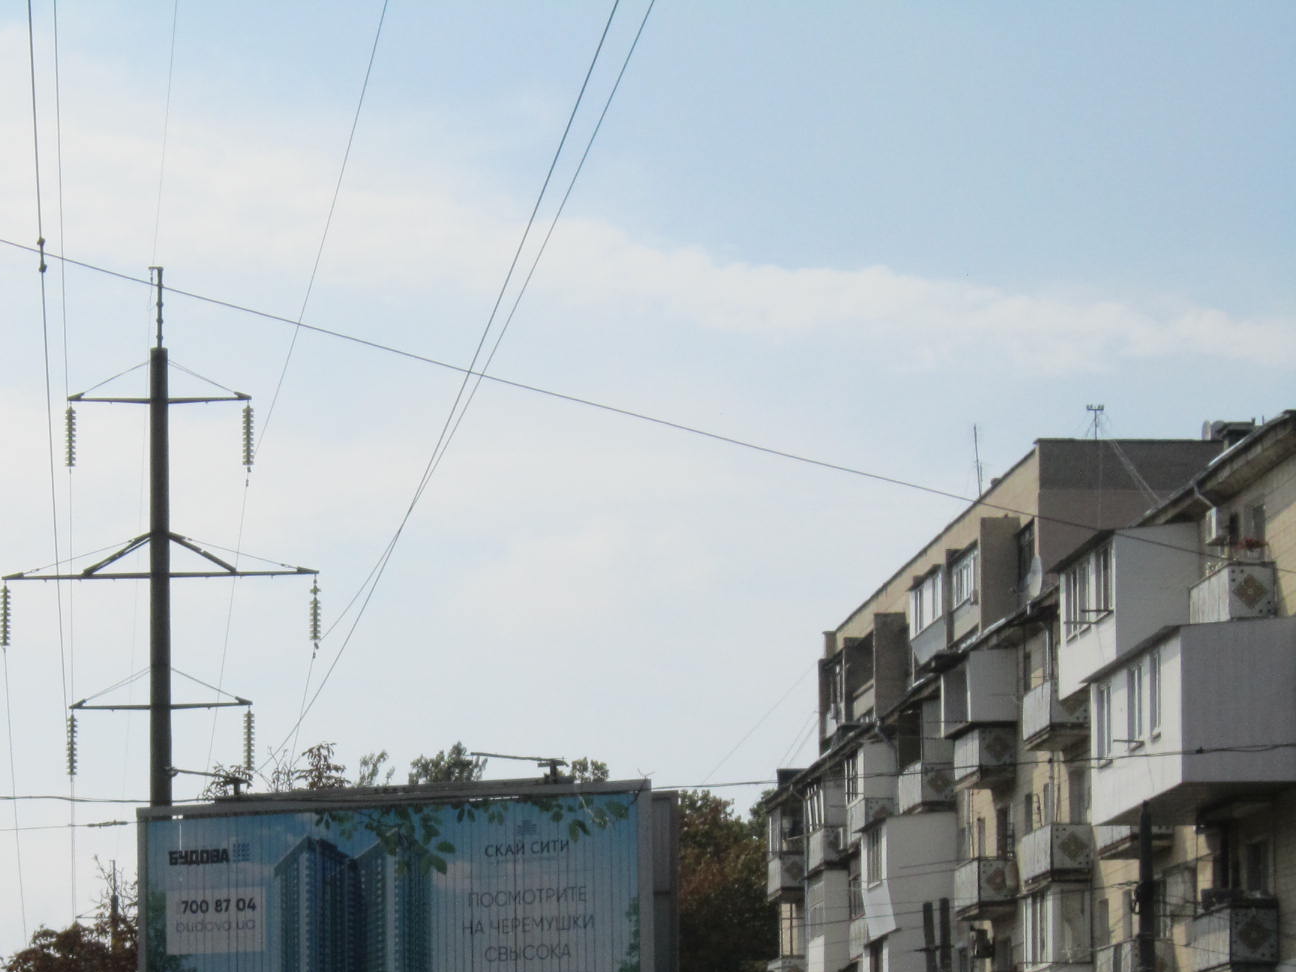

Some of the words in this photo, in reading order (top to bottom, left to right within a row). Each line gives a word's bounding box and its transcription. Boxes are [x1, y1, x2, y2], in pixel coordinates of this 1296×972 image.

[530, 839, 570, 855] СИТИ
[168, 848, 230, 866] БУДОВА
[181, 899, 209, 915] 700
[214, 898, 231, 914] 87
[236, 897, 257, 912] 04
[467, 886, 588, 908] ПОСМОТРИТЕ
[462, 918, 485, 936] НА
[490, 914, 595, 936] ЧЕРЕМУШКИ
[484, 943, 572, 963] СВЫСОКА
